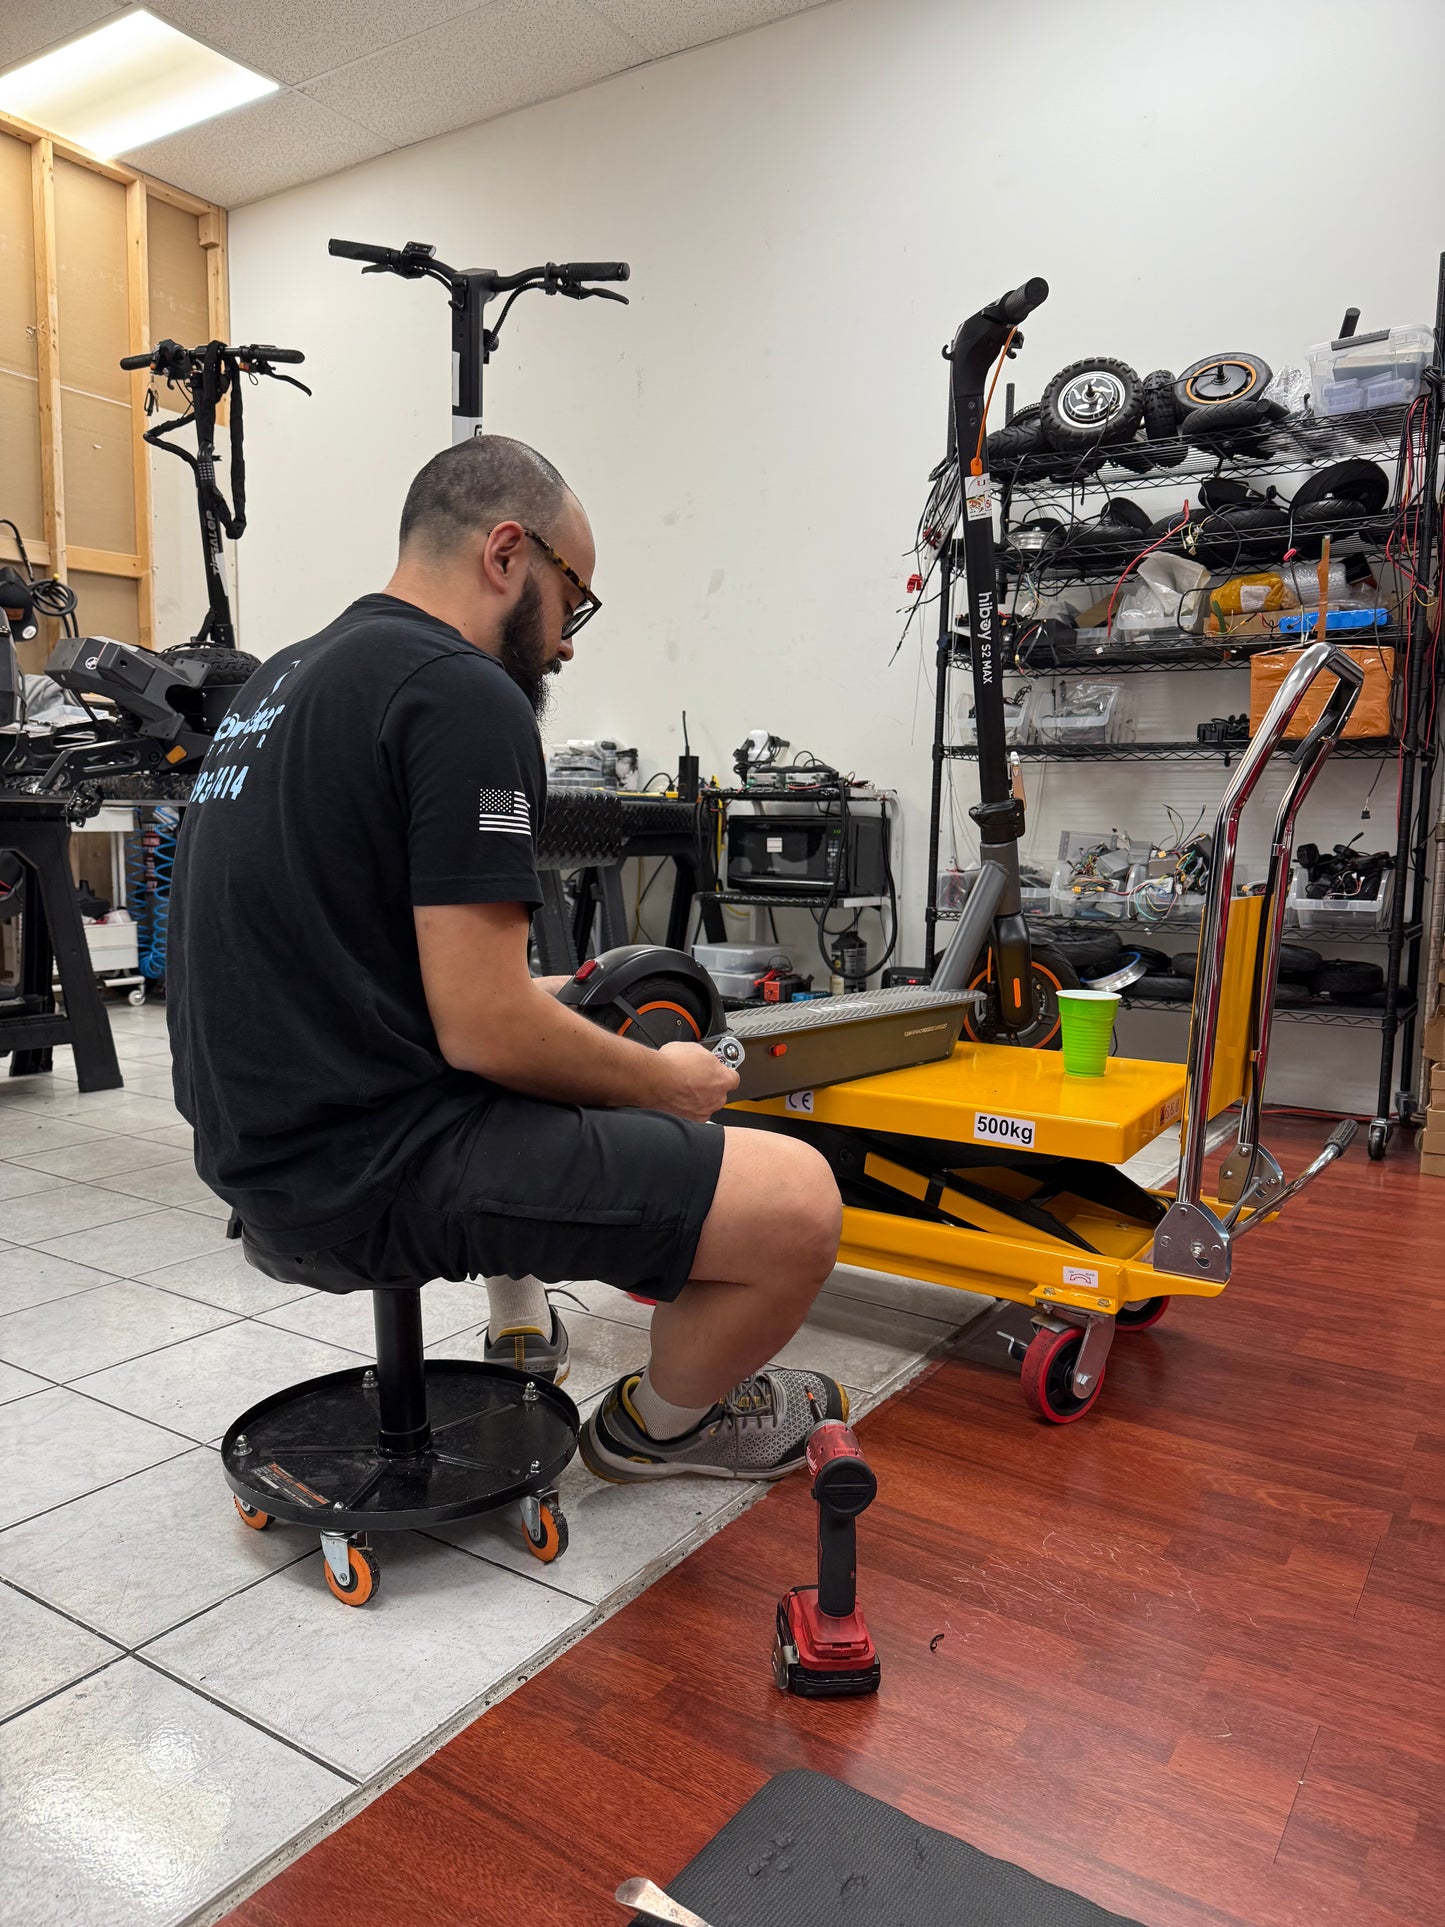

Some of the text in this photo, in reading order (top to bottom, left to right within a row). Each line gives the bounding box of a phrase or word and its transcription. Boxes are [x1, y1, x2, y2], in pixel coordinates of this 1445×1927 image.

[977, 591, 993, 685] hiboy S2 MAX
[977, 1115, 1033, 1145] 500kg
